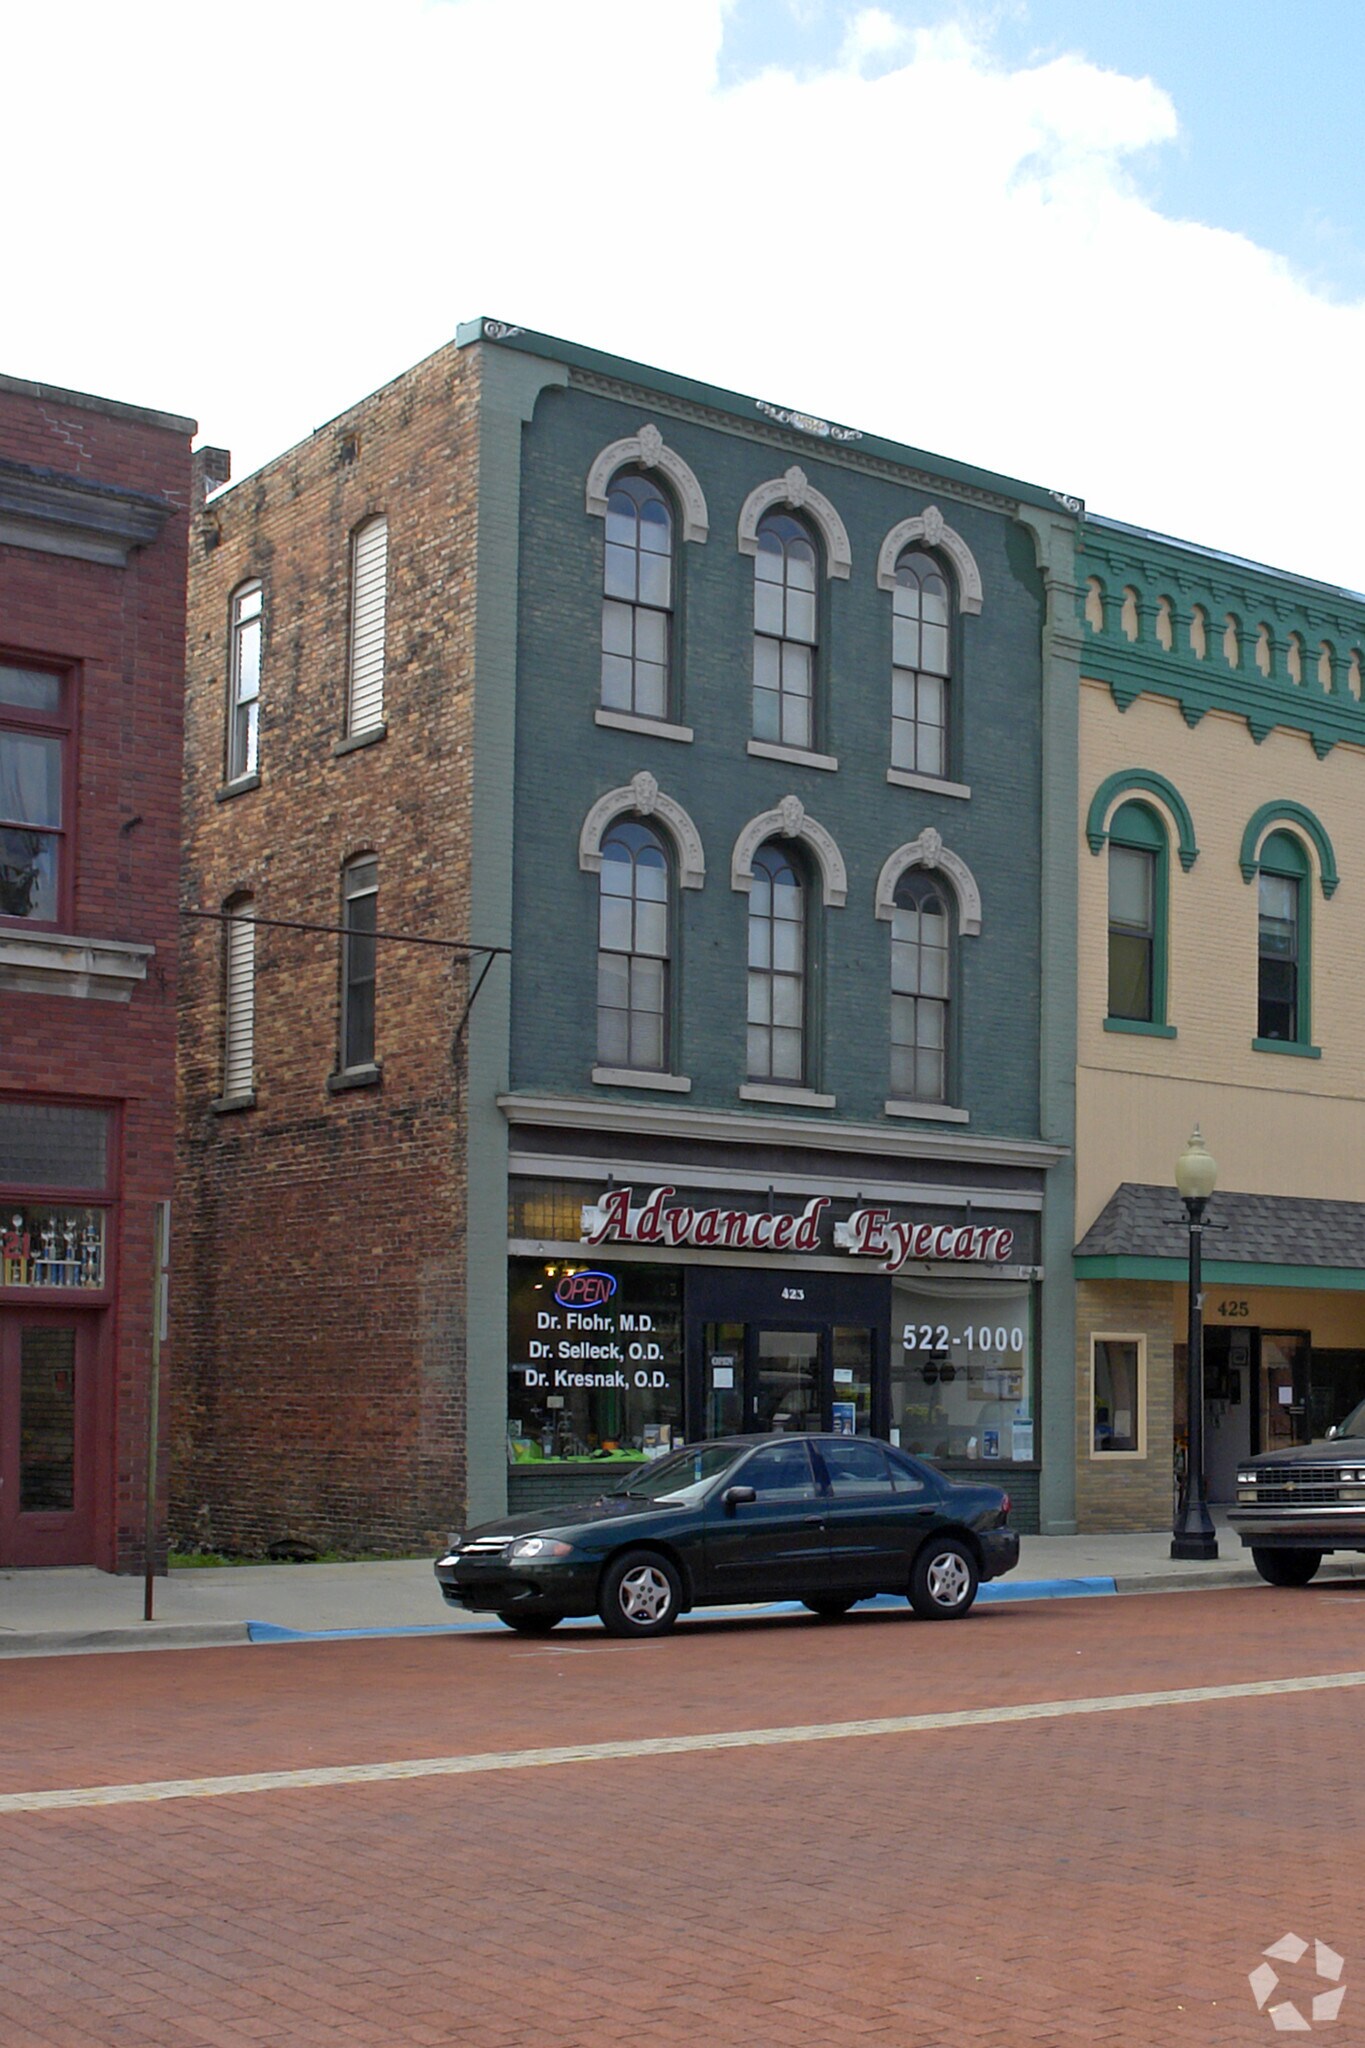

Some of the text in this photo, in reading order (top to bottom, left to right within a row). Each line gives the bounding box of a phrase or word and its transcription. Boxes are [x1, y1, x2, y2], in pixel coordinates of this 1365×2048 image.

[588, 1186, 1014, 1271] Advanced Eyecare
[556, 1277, 612, 1303] OPEN
[781, 1287, 805, 1302] 423
[1218, 1301, 1249, 1316] 425
[537, 1312, 656, 1333] Dr. Flohr, M.D.
[903, 1323, 1024, 1352] 522-1000
[529, 1341, 664, 1362] Dr. Selleck, O.D.
[525, 1369, 670, 1391] Dr. Kresnak, O.D.
